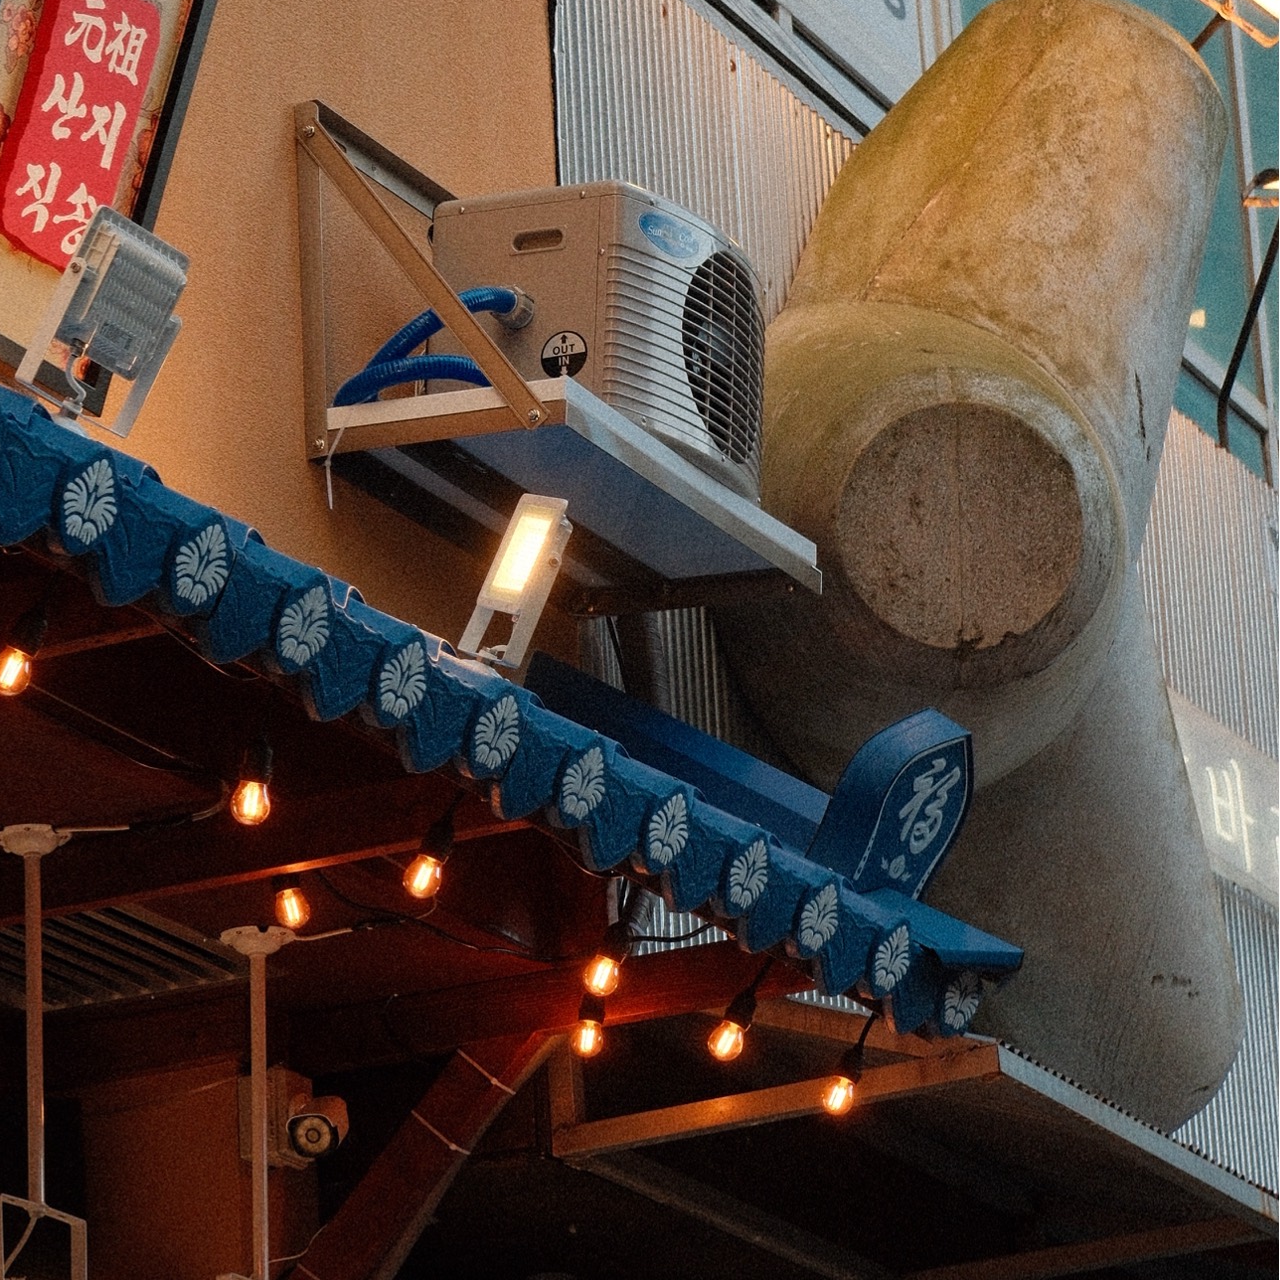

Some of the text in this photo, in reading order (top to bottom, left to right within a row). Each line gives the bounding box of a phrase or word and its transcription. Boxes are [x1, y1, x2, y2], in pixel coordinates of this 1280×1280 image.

[41, 72, 126, 170] 산지
[552, 342, 575, 357] OUT
[558, 354, 570, 367] IN
